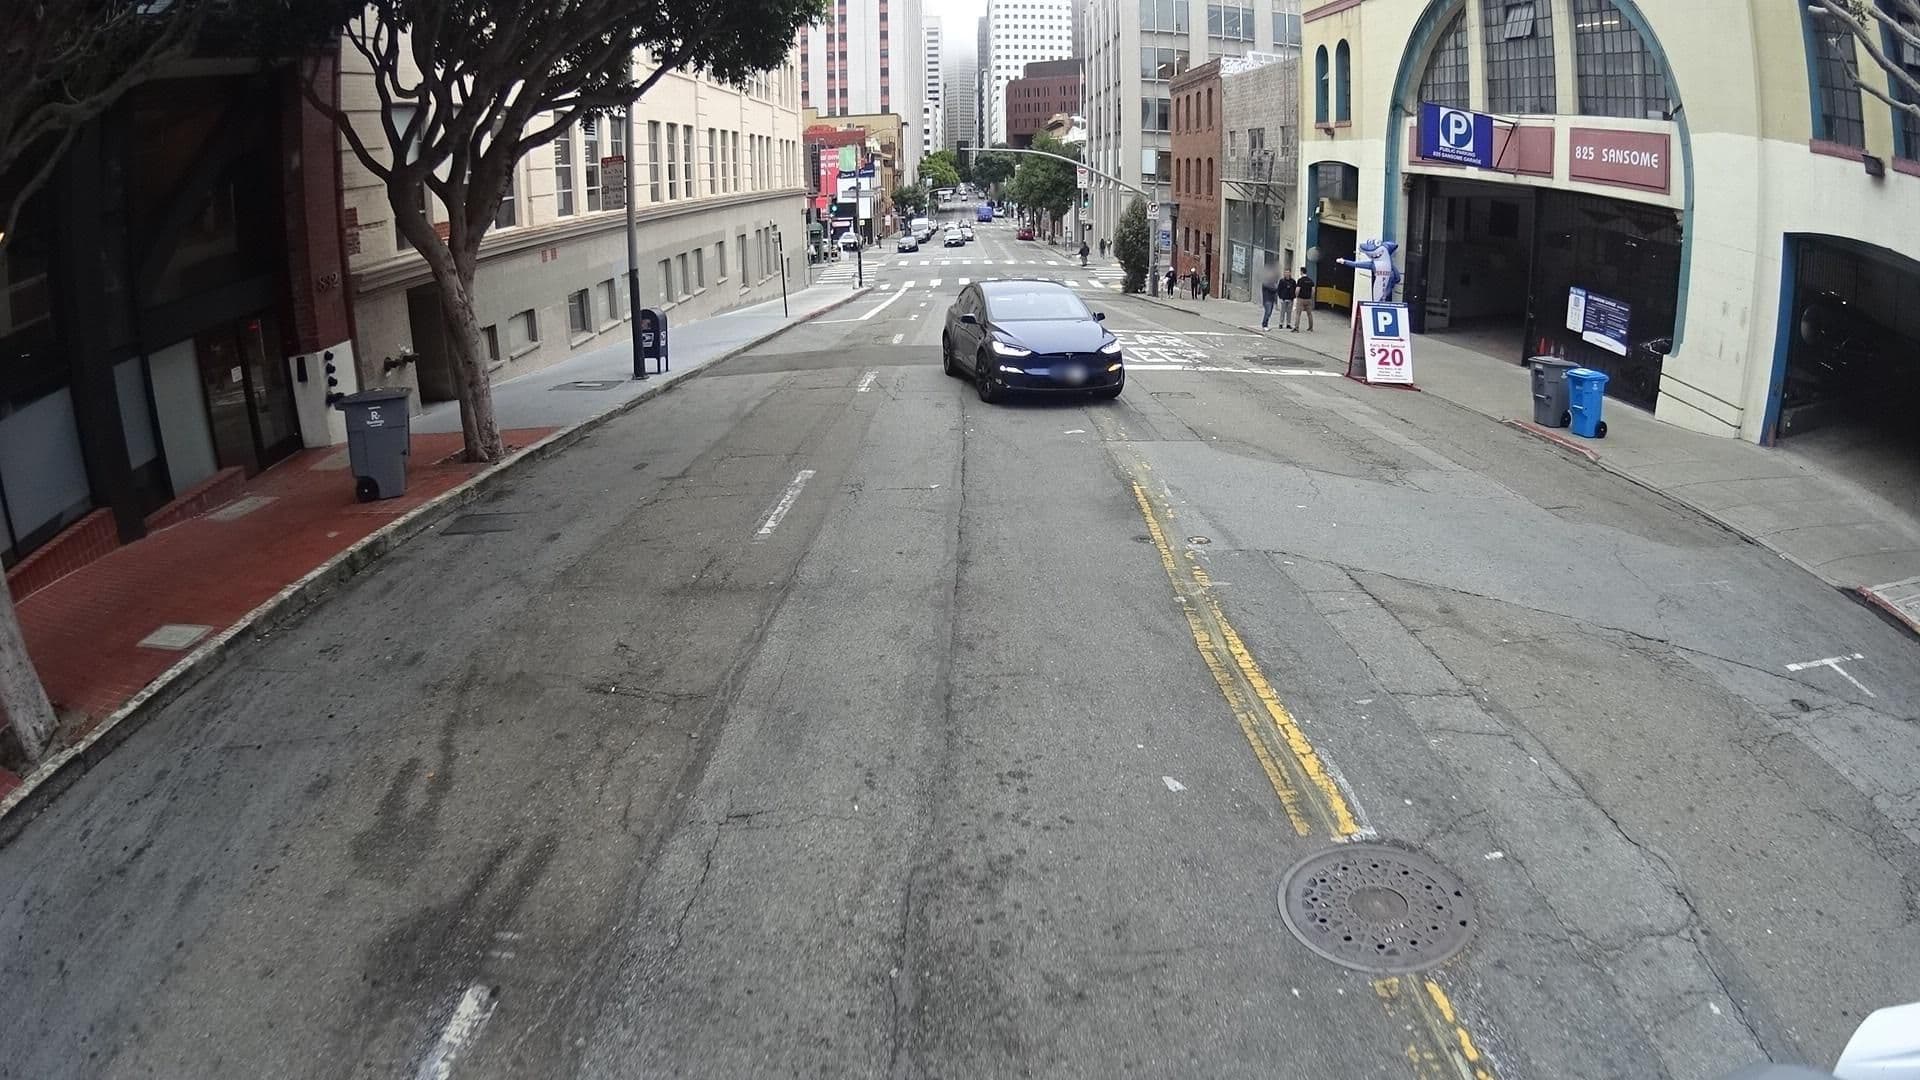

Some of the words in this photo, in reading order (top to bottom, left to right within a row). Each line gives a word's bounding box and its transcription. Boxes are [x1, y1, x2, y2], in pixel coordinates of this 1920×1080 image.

[1449, 113, 1468, 145] P
[1442, 152, 1463, 161] SANSOME
[1463, 157, 1481, 165] GARAGE
[1575, 146, 1595, 160] 825
[1601, 148, 1659, 168] SANSOME
[1377, 311, 1393, 333] P
[1369, 348, 1404, 367] $20
